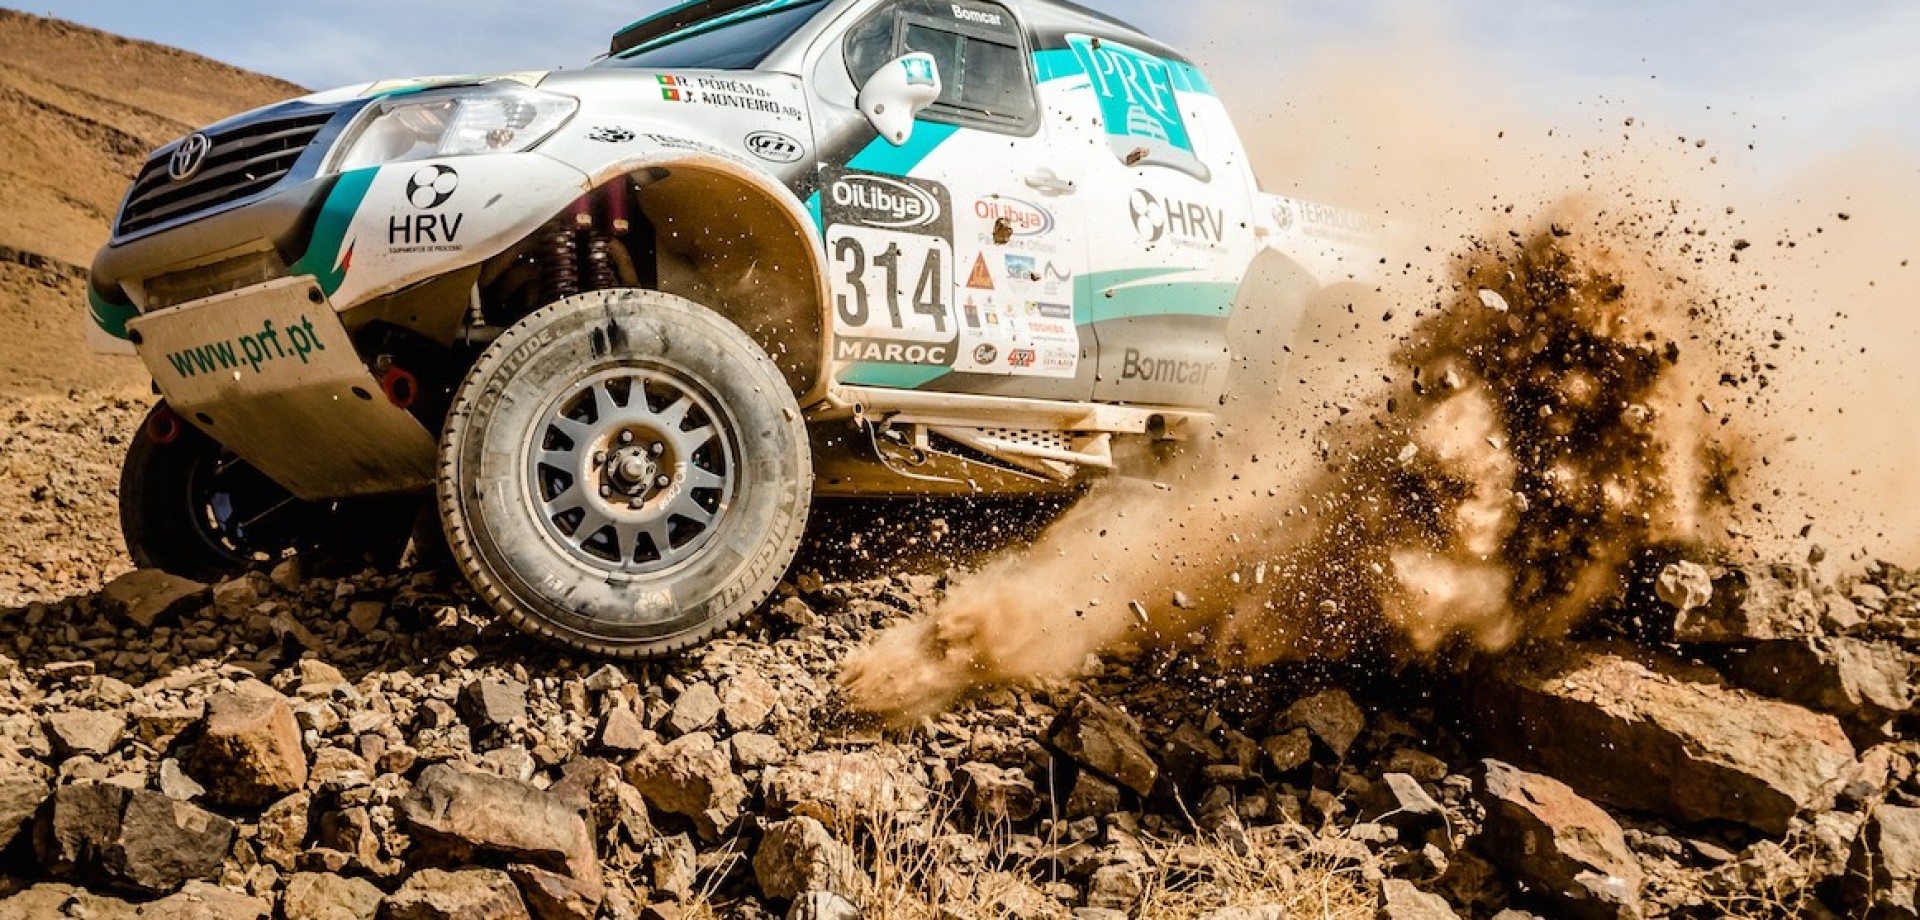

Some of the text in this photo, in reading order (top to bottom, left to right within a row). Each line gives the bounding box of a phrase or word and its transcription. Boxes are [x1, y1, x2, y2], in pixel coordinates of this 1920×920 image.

[952, 4, 1001, 26] Bomcar
[702, 91, 780, 113] MONTEIRO
[1086, 42, 1176, 125] PRF
[389, 212, 463, 244] HRV
[1165, 197, 1223, 243] HRV
[835, 235, 948, 333] 314
[166, 314, 325, 379] www.prf.pt
[837, 341, 946, 363] MAROC
[1122, 348, 1214, 385] Bomcar
